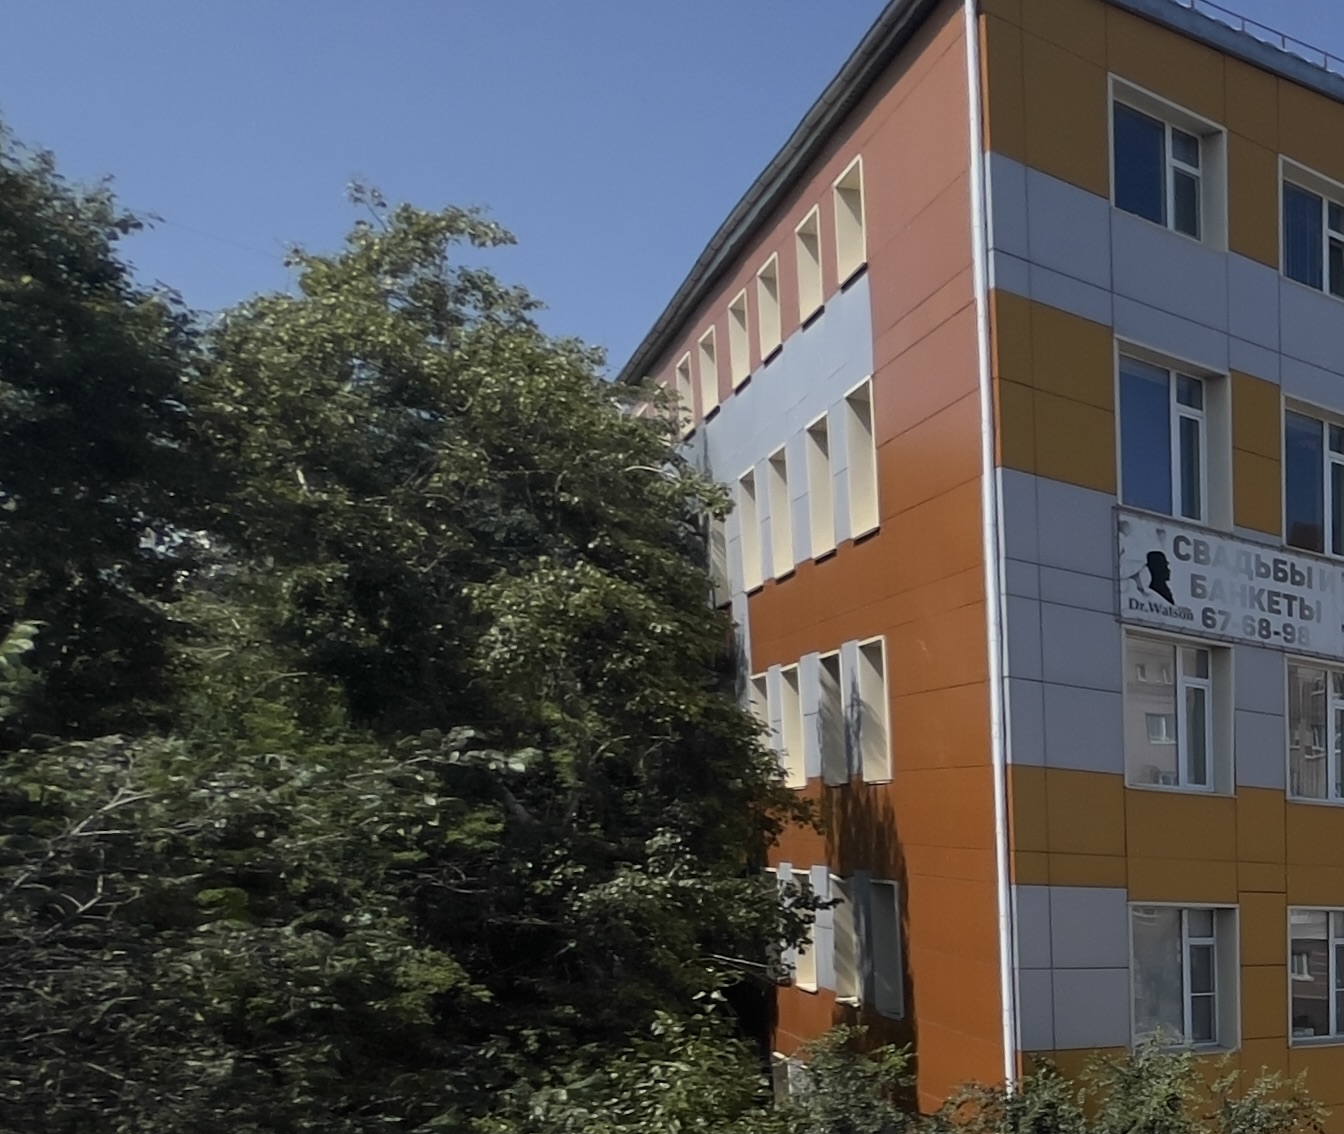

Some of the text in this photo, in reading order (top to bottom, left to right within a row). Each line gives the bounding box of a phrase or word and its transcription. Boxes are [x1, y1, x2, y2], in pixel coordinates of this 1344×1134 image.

[1172, 534, 1313, 590] СВАДЬБЫ
[1190, 572, 1322, 624] БАНКЕТЫ
[1201, 606, 1311, 647] 67-68-98
